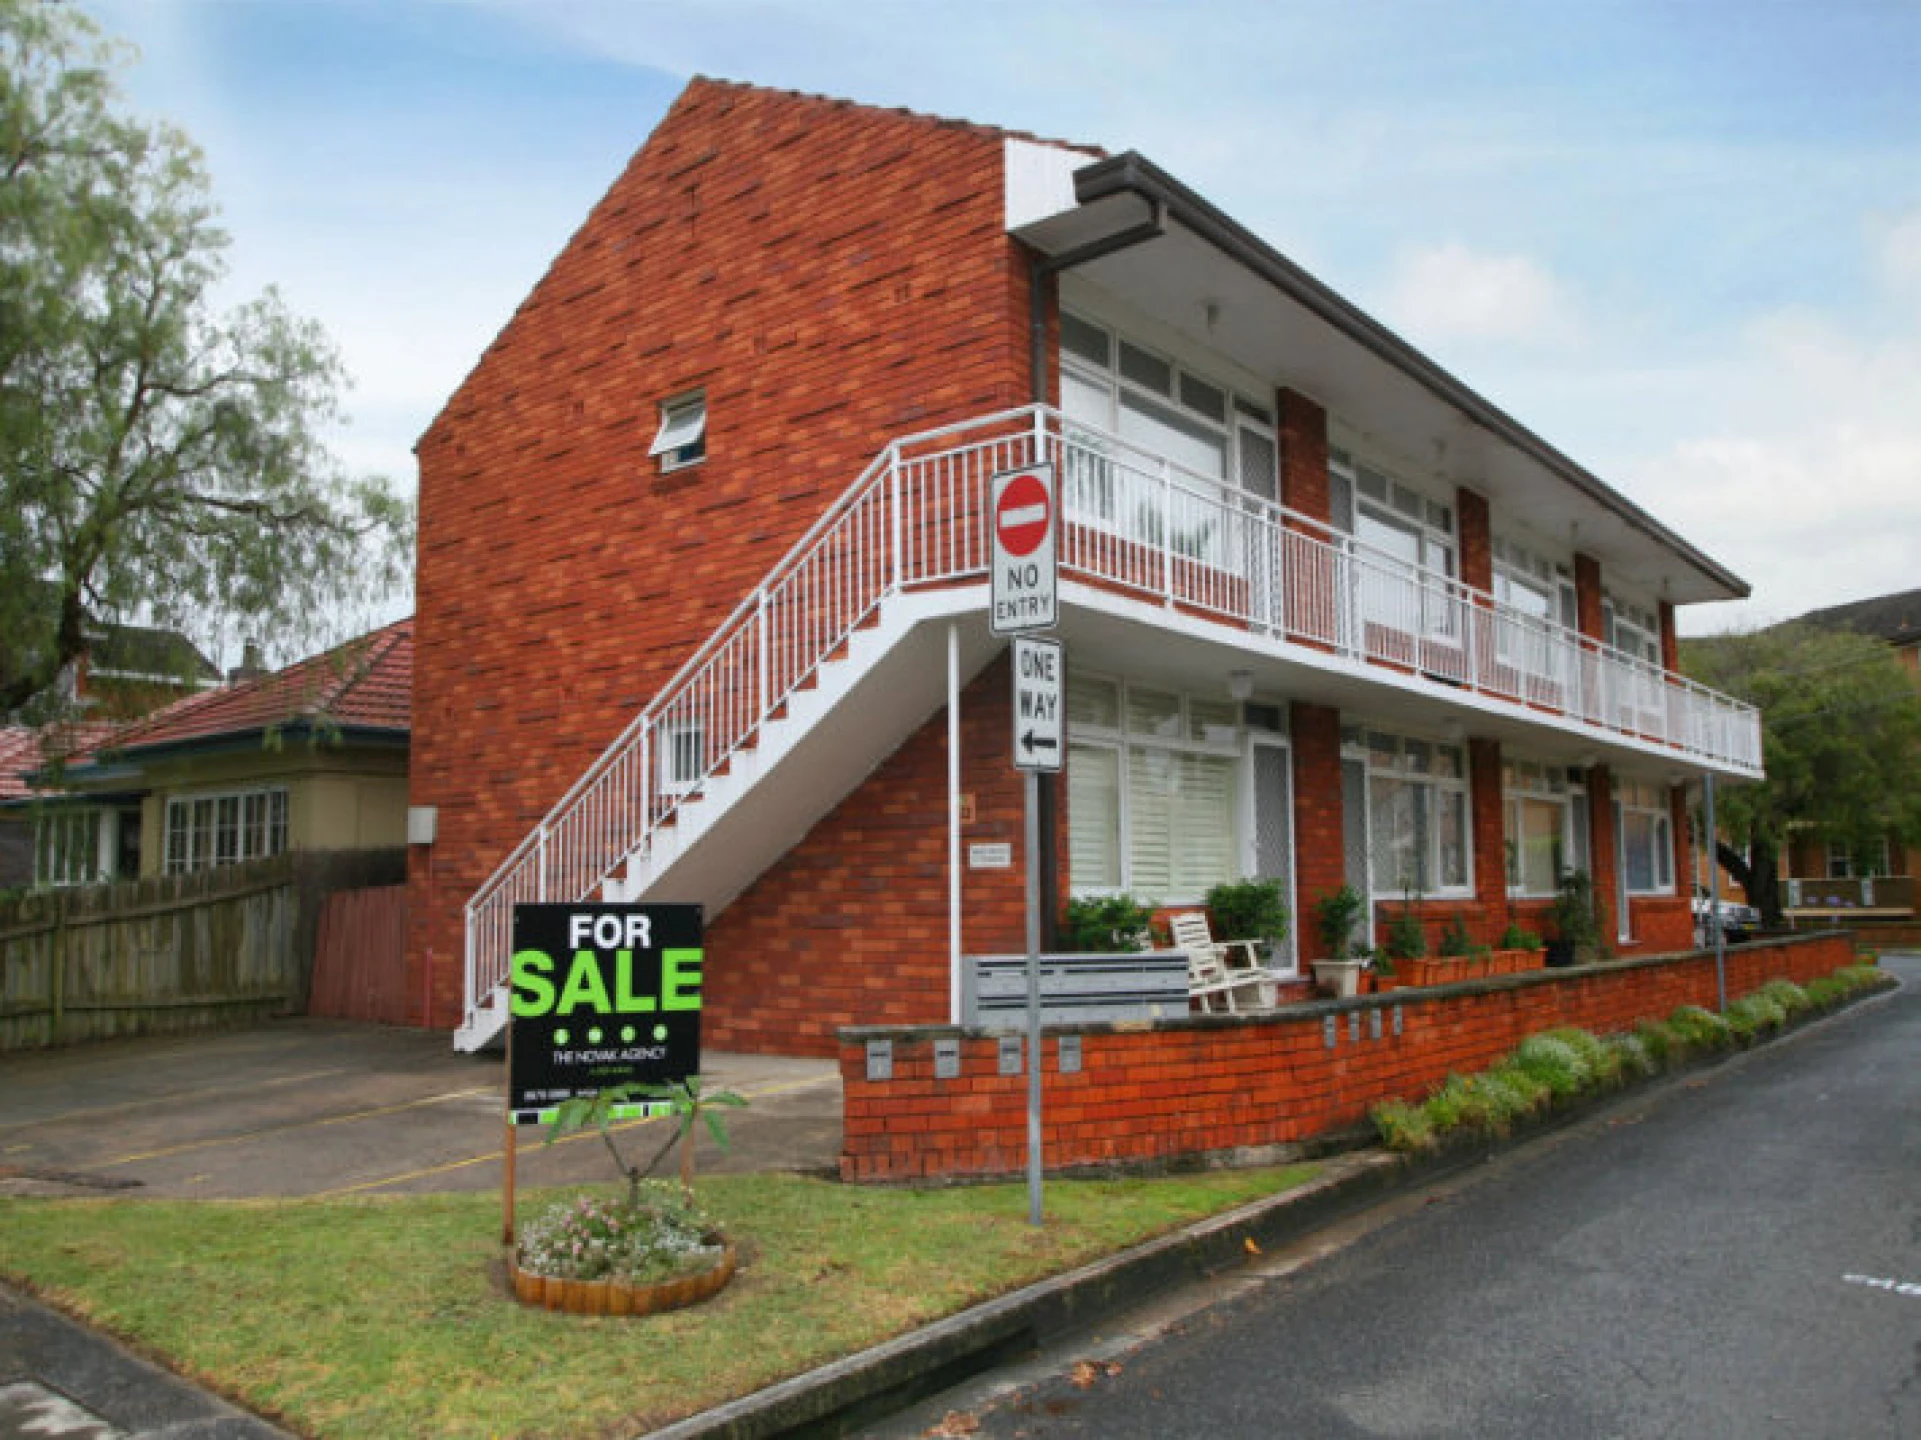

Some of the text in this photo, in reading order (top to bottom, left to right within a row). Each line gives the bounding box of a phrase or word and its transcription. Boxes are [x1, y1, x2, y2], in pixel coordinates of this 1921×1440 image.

[1007, 564, 1039, 592] NO
[996, 593, 1051, 620] ENTRY
[1020, 649, 1055, 682] ONE
[1020, 690, 1057, 721] WAY
[569, 914, 652, 950] FOR
[510, 947, 704, 1017] SALE
[553, 1050, 574, 1065] THE
[620, 1045, 666, 1061] AGENCY
